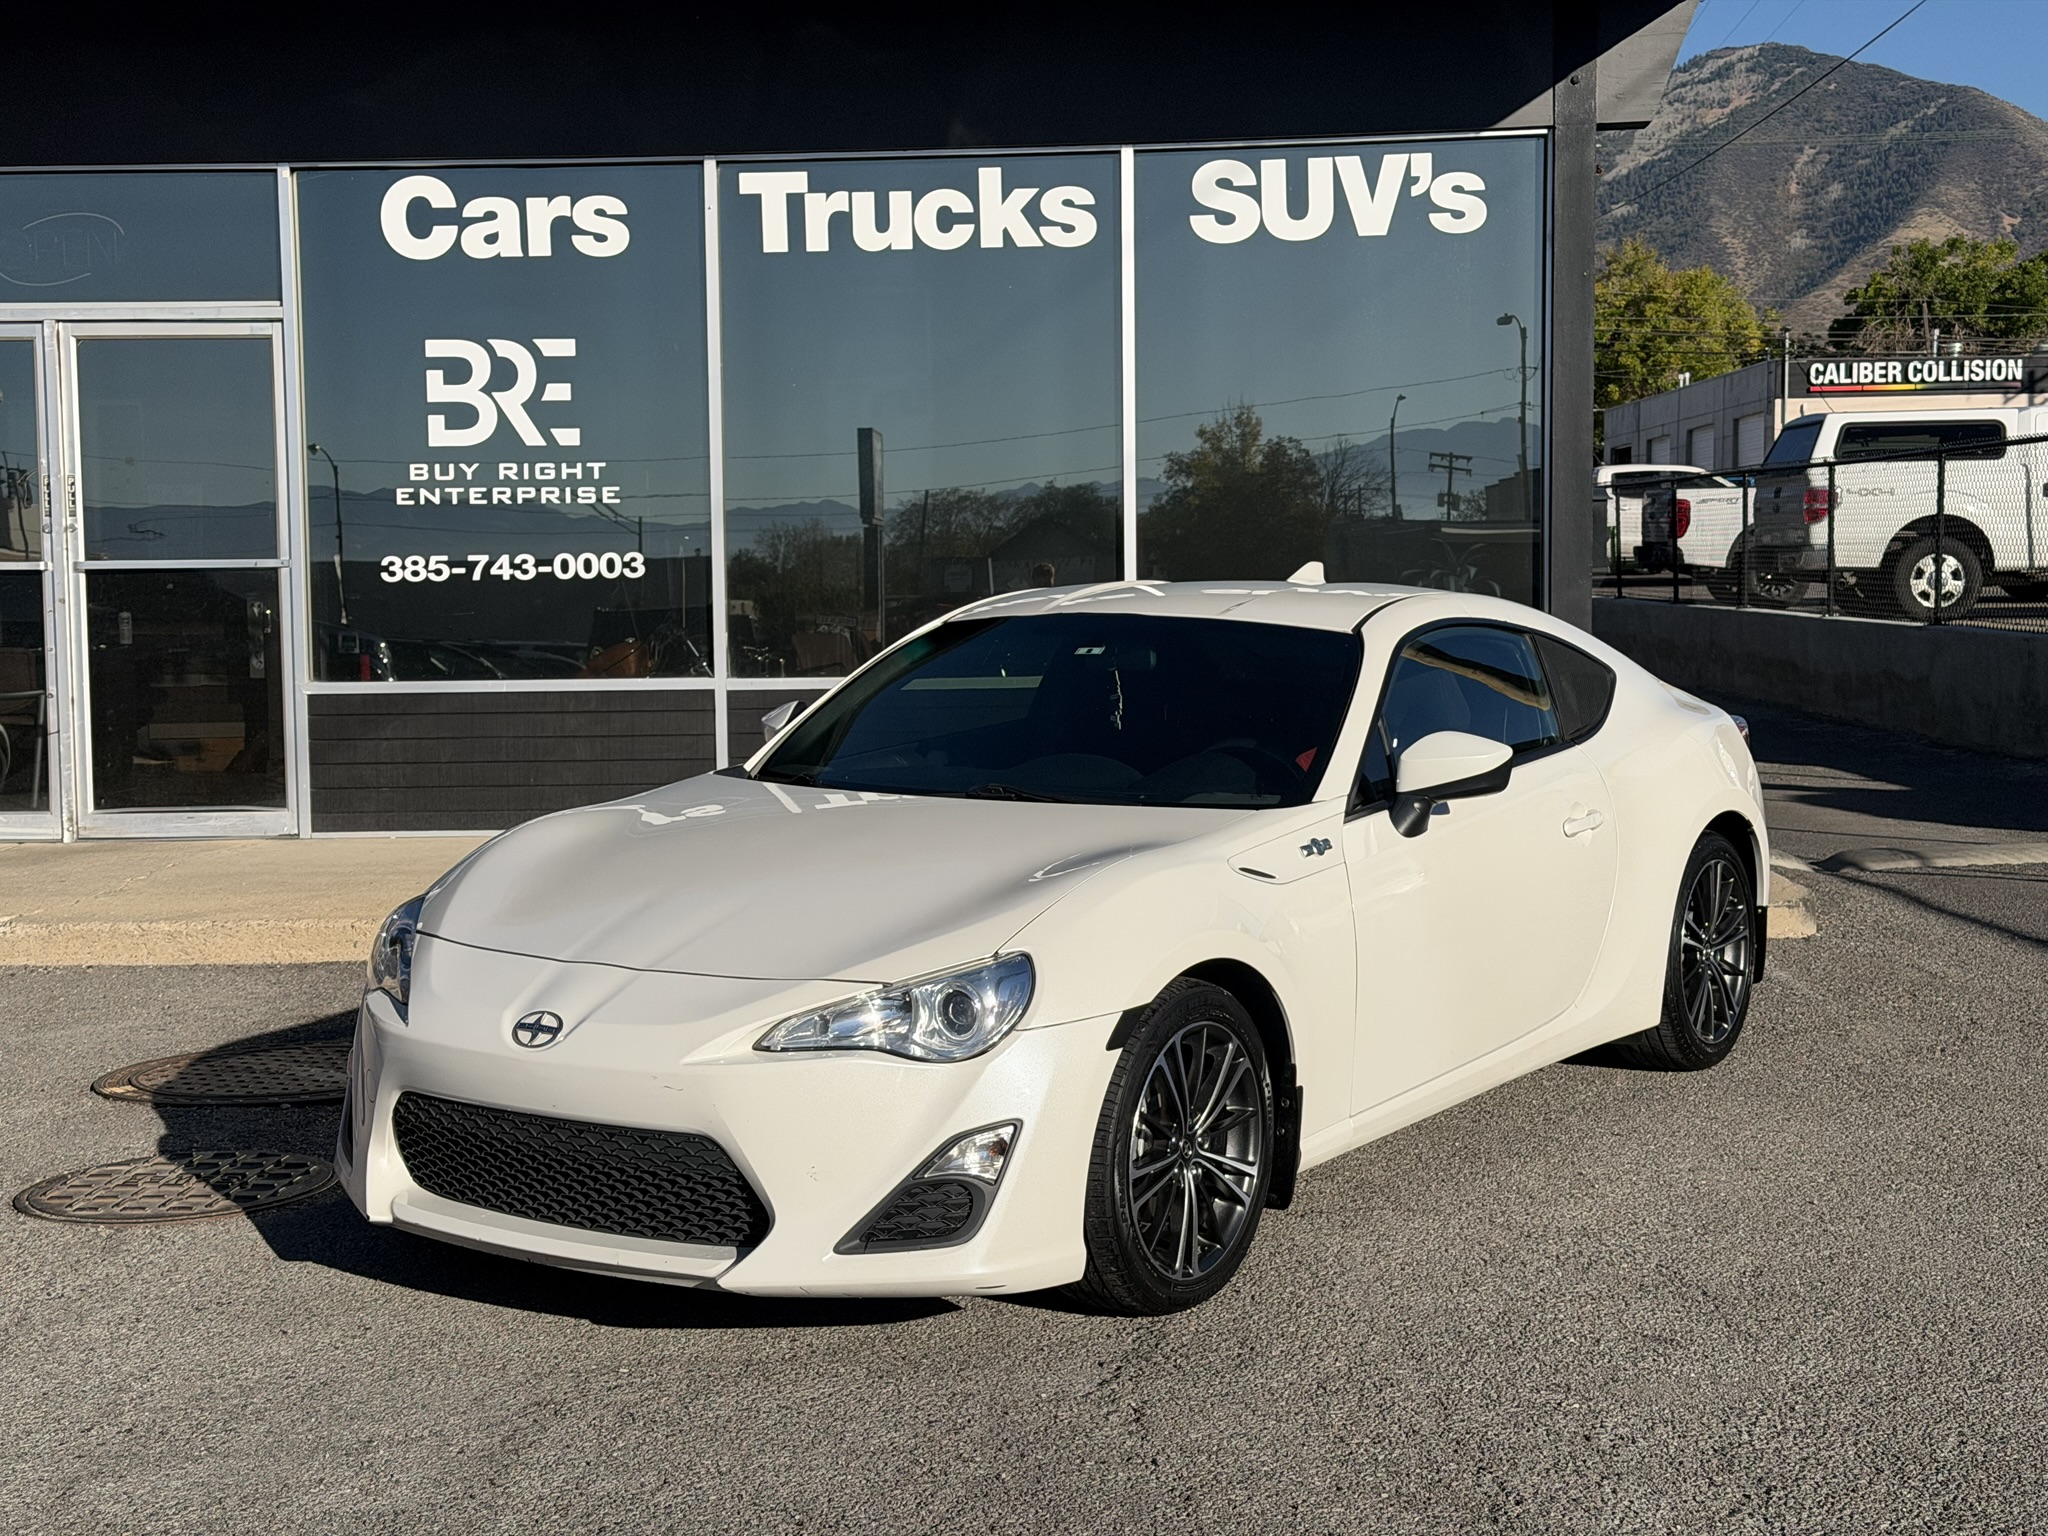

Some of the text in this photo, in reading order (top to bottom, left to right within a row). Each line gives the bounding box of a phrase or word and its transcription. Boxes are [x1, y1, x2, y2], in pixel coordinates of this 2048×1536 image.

[380, 175, 630, 261] Cars
[738, 166, 1098, 254] Trucks
[1189, 152, 1488, 245] SUV's
[424, 338, 581, 448] BRE
[1809, 359, 2023, 385] CALIBER COLLISION
[395, 486, 621, 506] ENTERPRISE
[409, 461, 607, 481] BUY RIGHT
[380, 551, 646, 583] 385-743-0003
